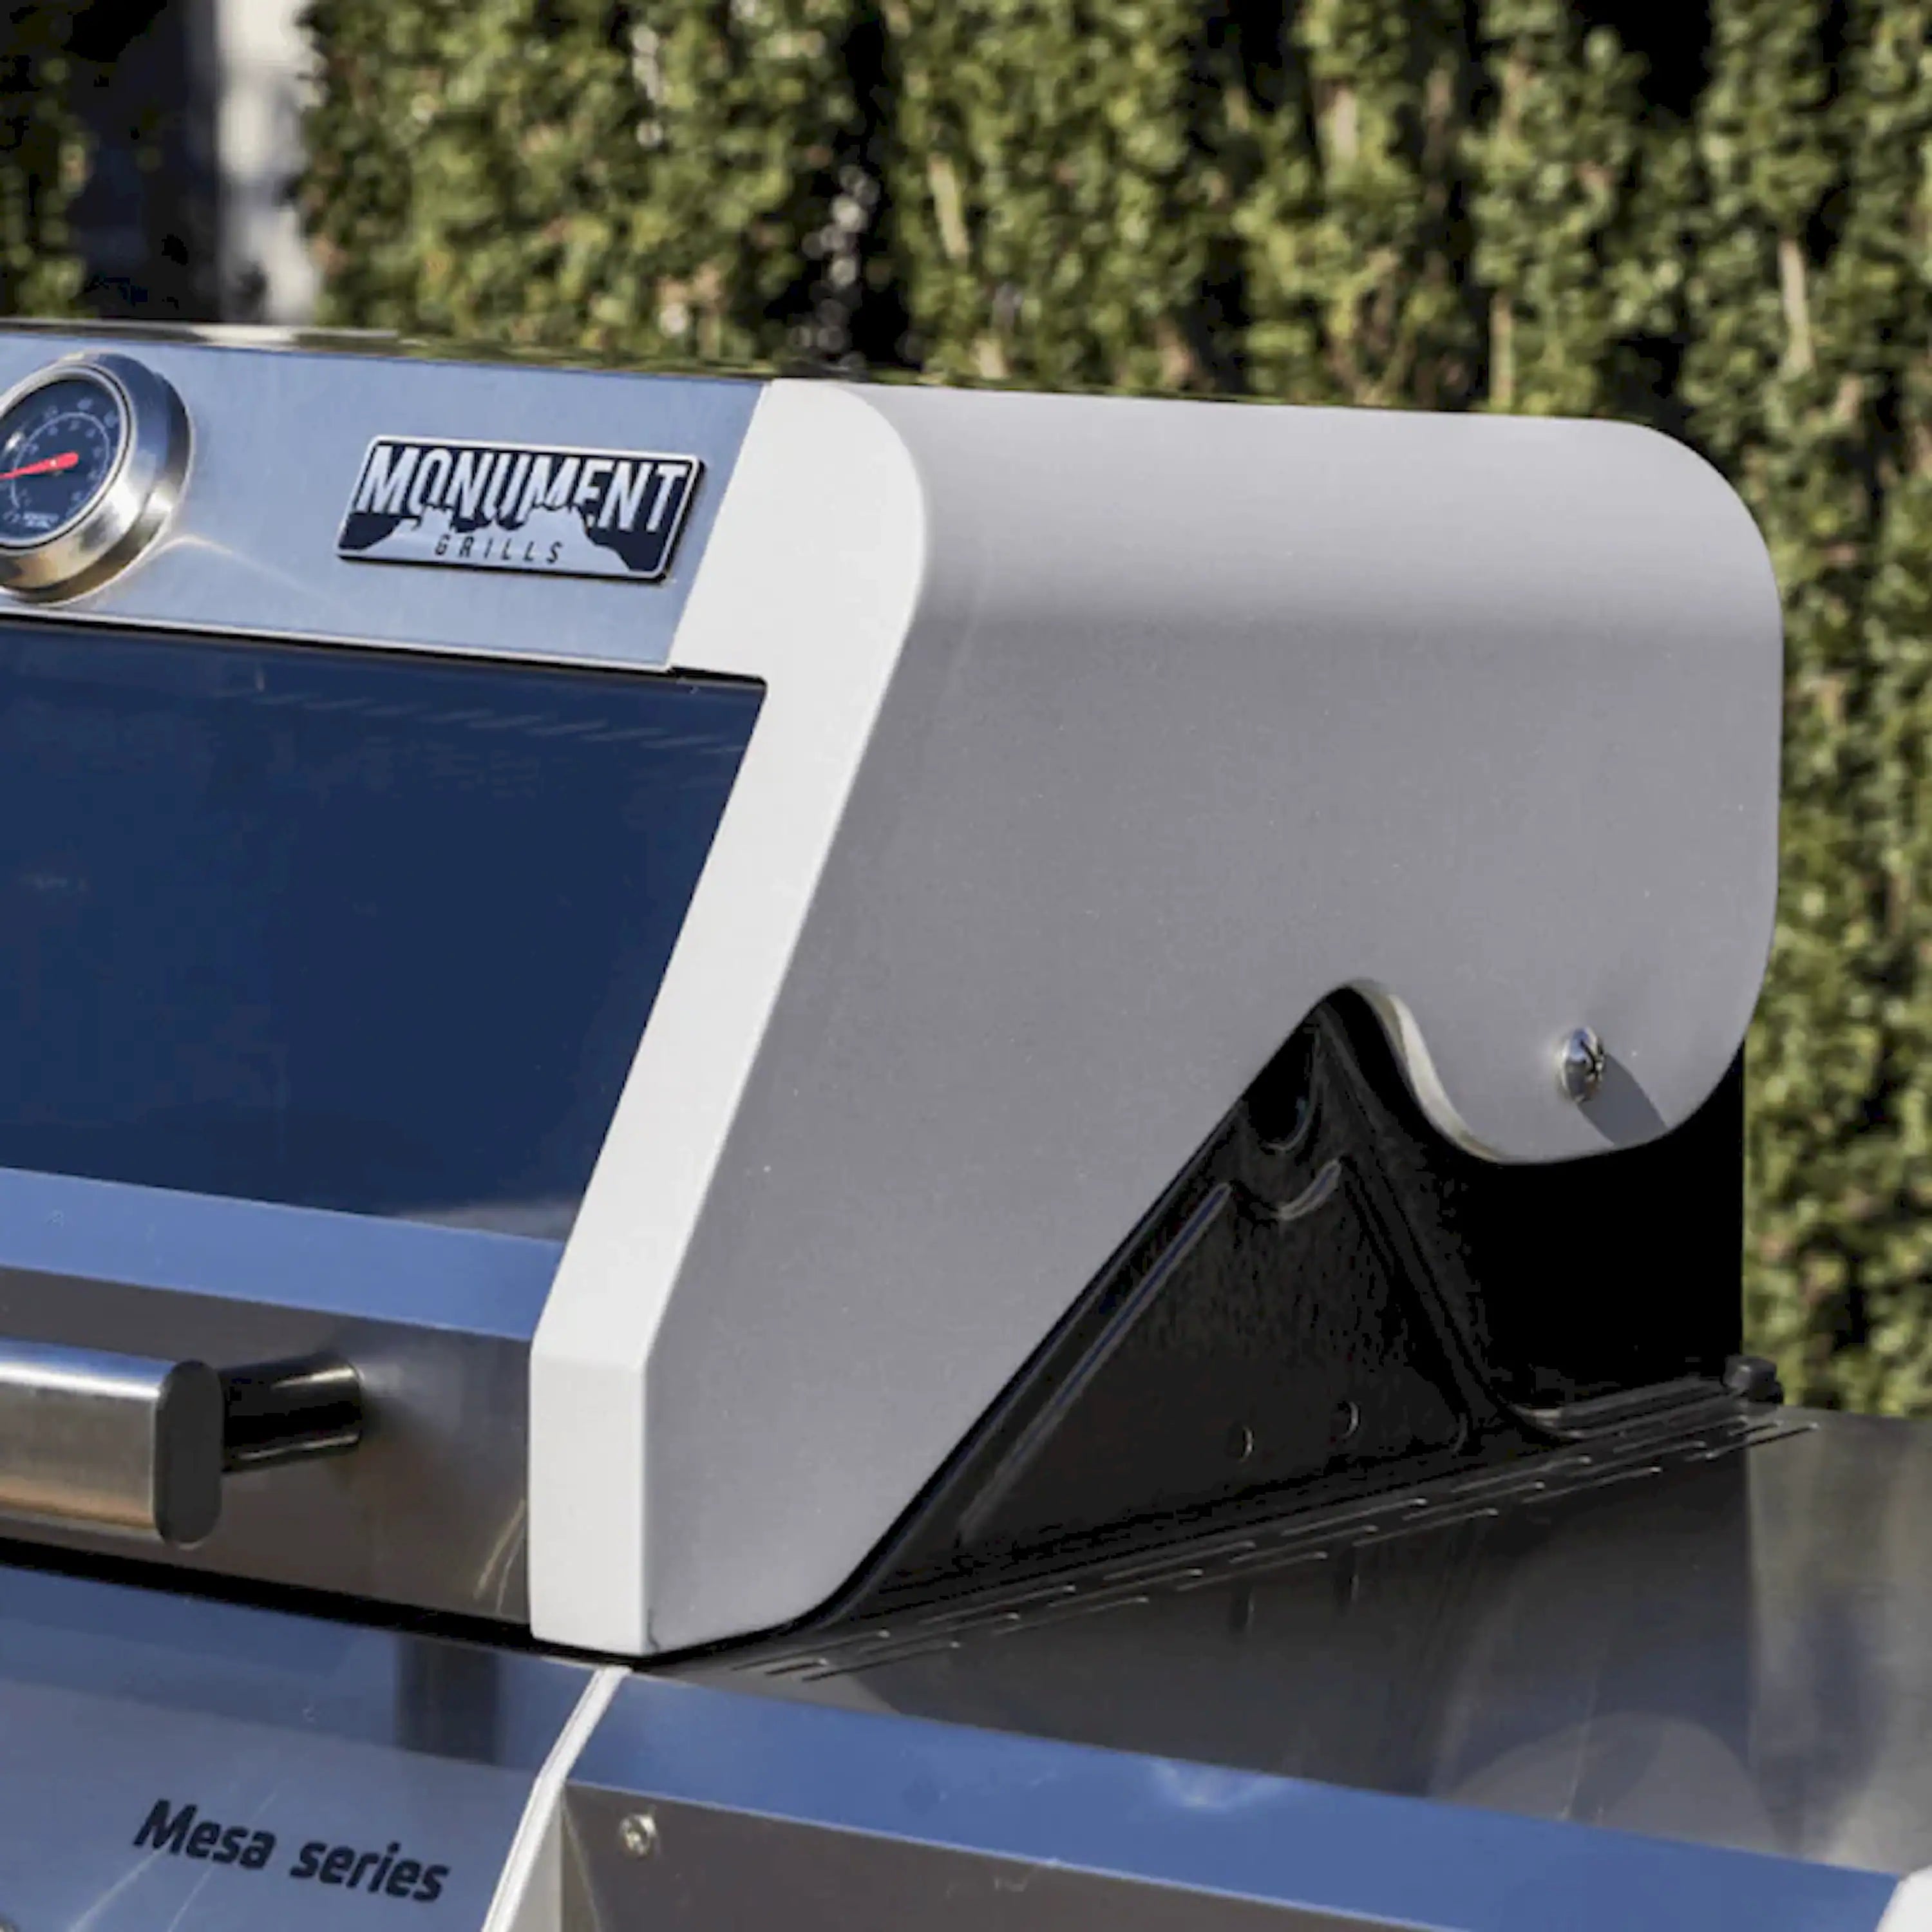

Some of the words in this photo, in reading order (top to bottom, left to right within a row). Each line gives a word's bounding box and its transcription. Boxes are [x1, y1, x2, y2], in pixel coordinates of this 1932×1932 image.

[355, 445, 687, 532] MONUMENT
[435, 534, 564, 564] GRILLS
[133, 1799, 277, 1870] Mesa
[289, 1841, 451, 1903] series
